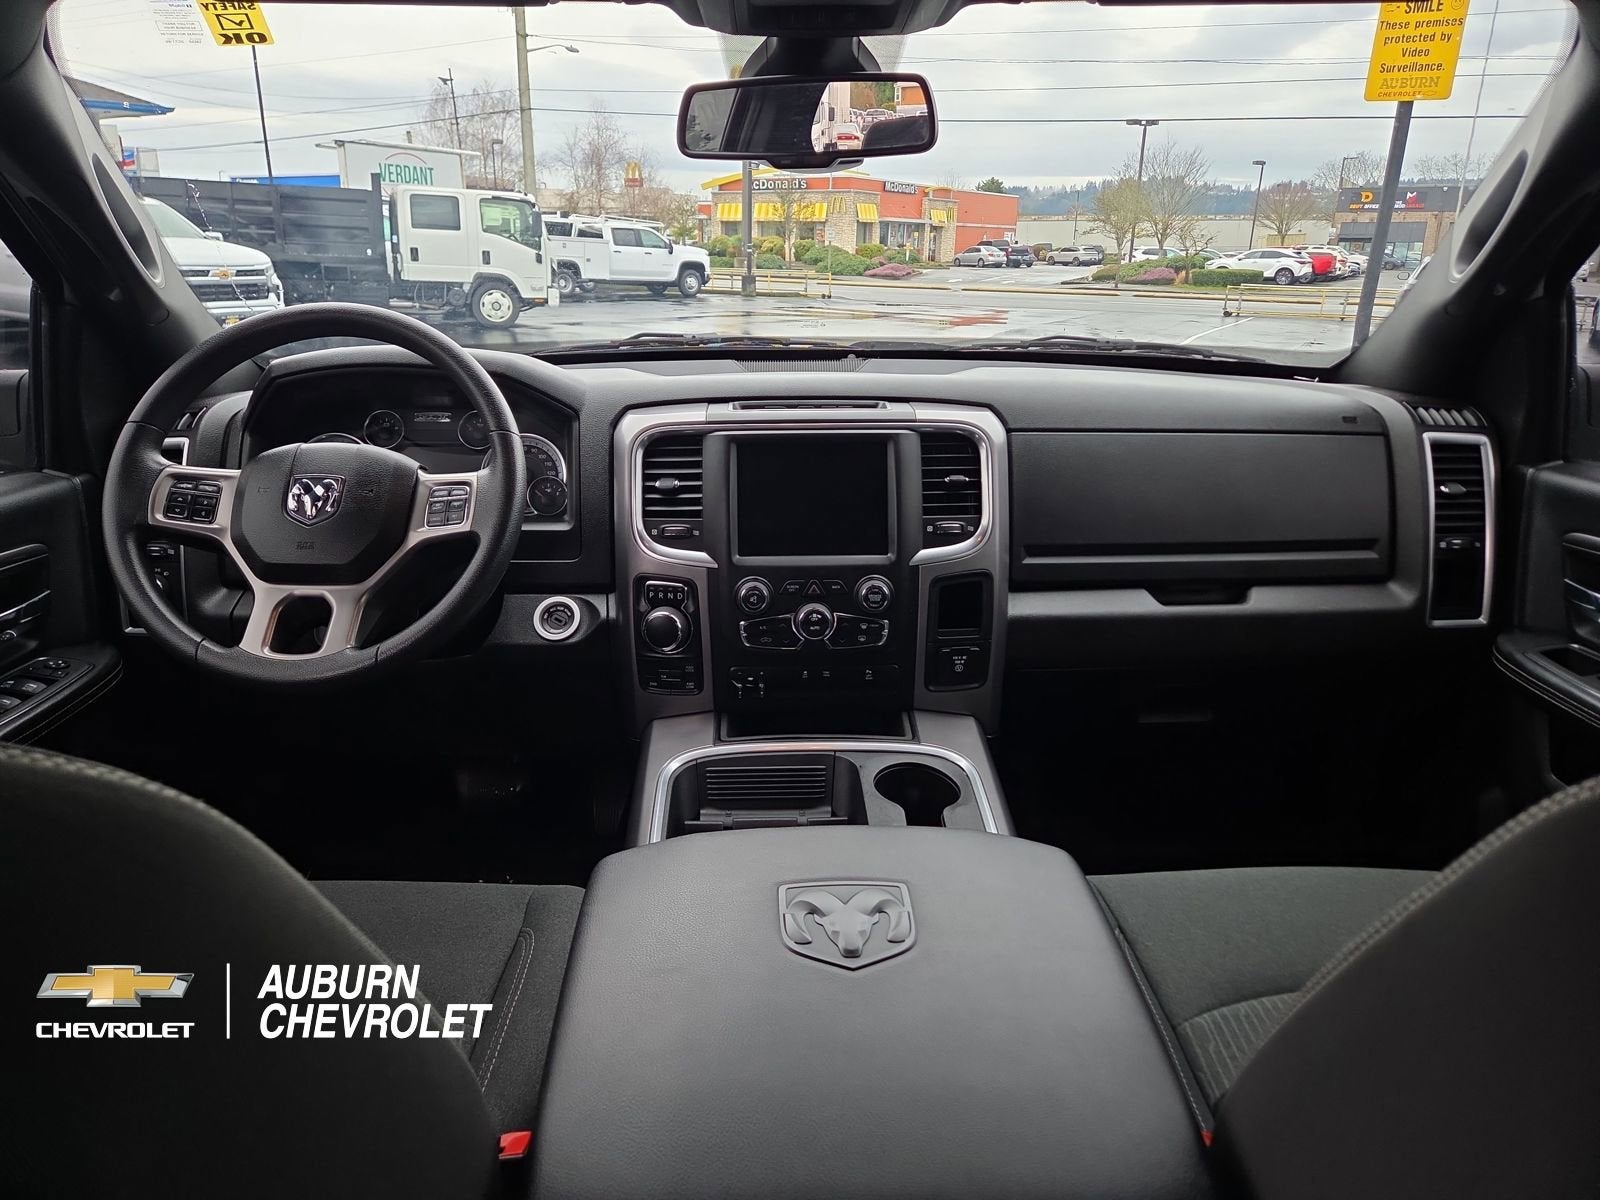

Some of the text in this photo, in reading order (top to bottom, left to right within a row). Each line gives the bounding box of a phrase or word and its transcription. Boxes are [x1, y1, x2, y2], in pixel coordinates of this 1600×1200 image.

[1405, 0, 1444, 14] SMILE
[1380, 16, 1464, 31] These premises
[1383, 31, 1453, 47] protected by
[1401, 47, 1430, 58] Video
[1379, 61, 1446, 74] Surveillance.
[1379, 76, 1441, 89] AUBURN
[1378, 90, 1422, 98] CHEVROLET
[378, 162, 435, 187] VERDANT
[751, 178, 807, 190] cDonald's
[884, 181, 918, 194] McDonald's
